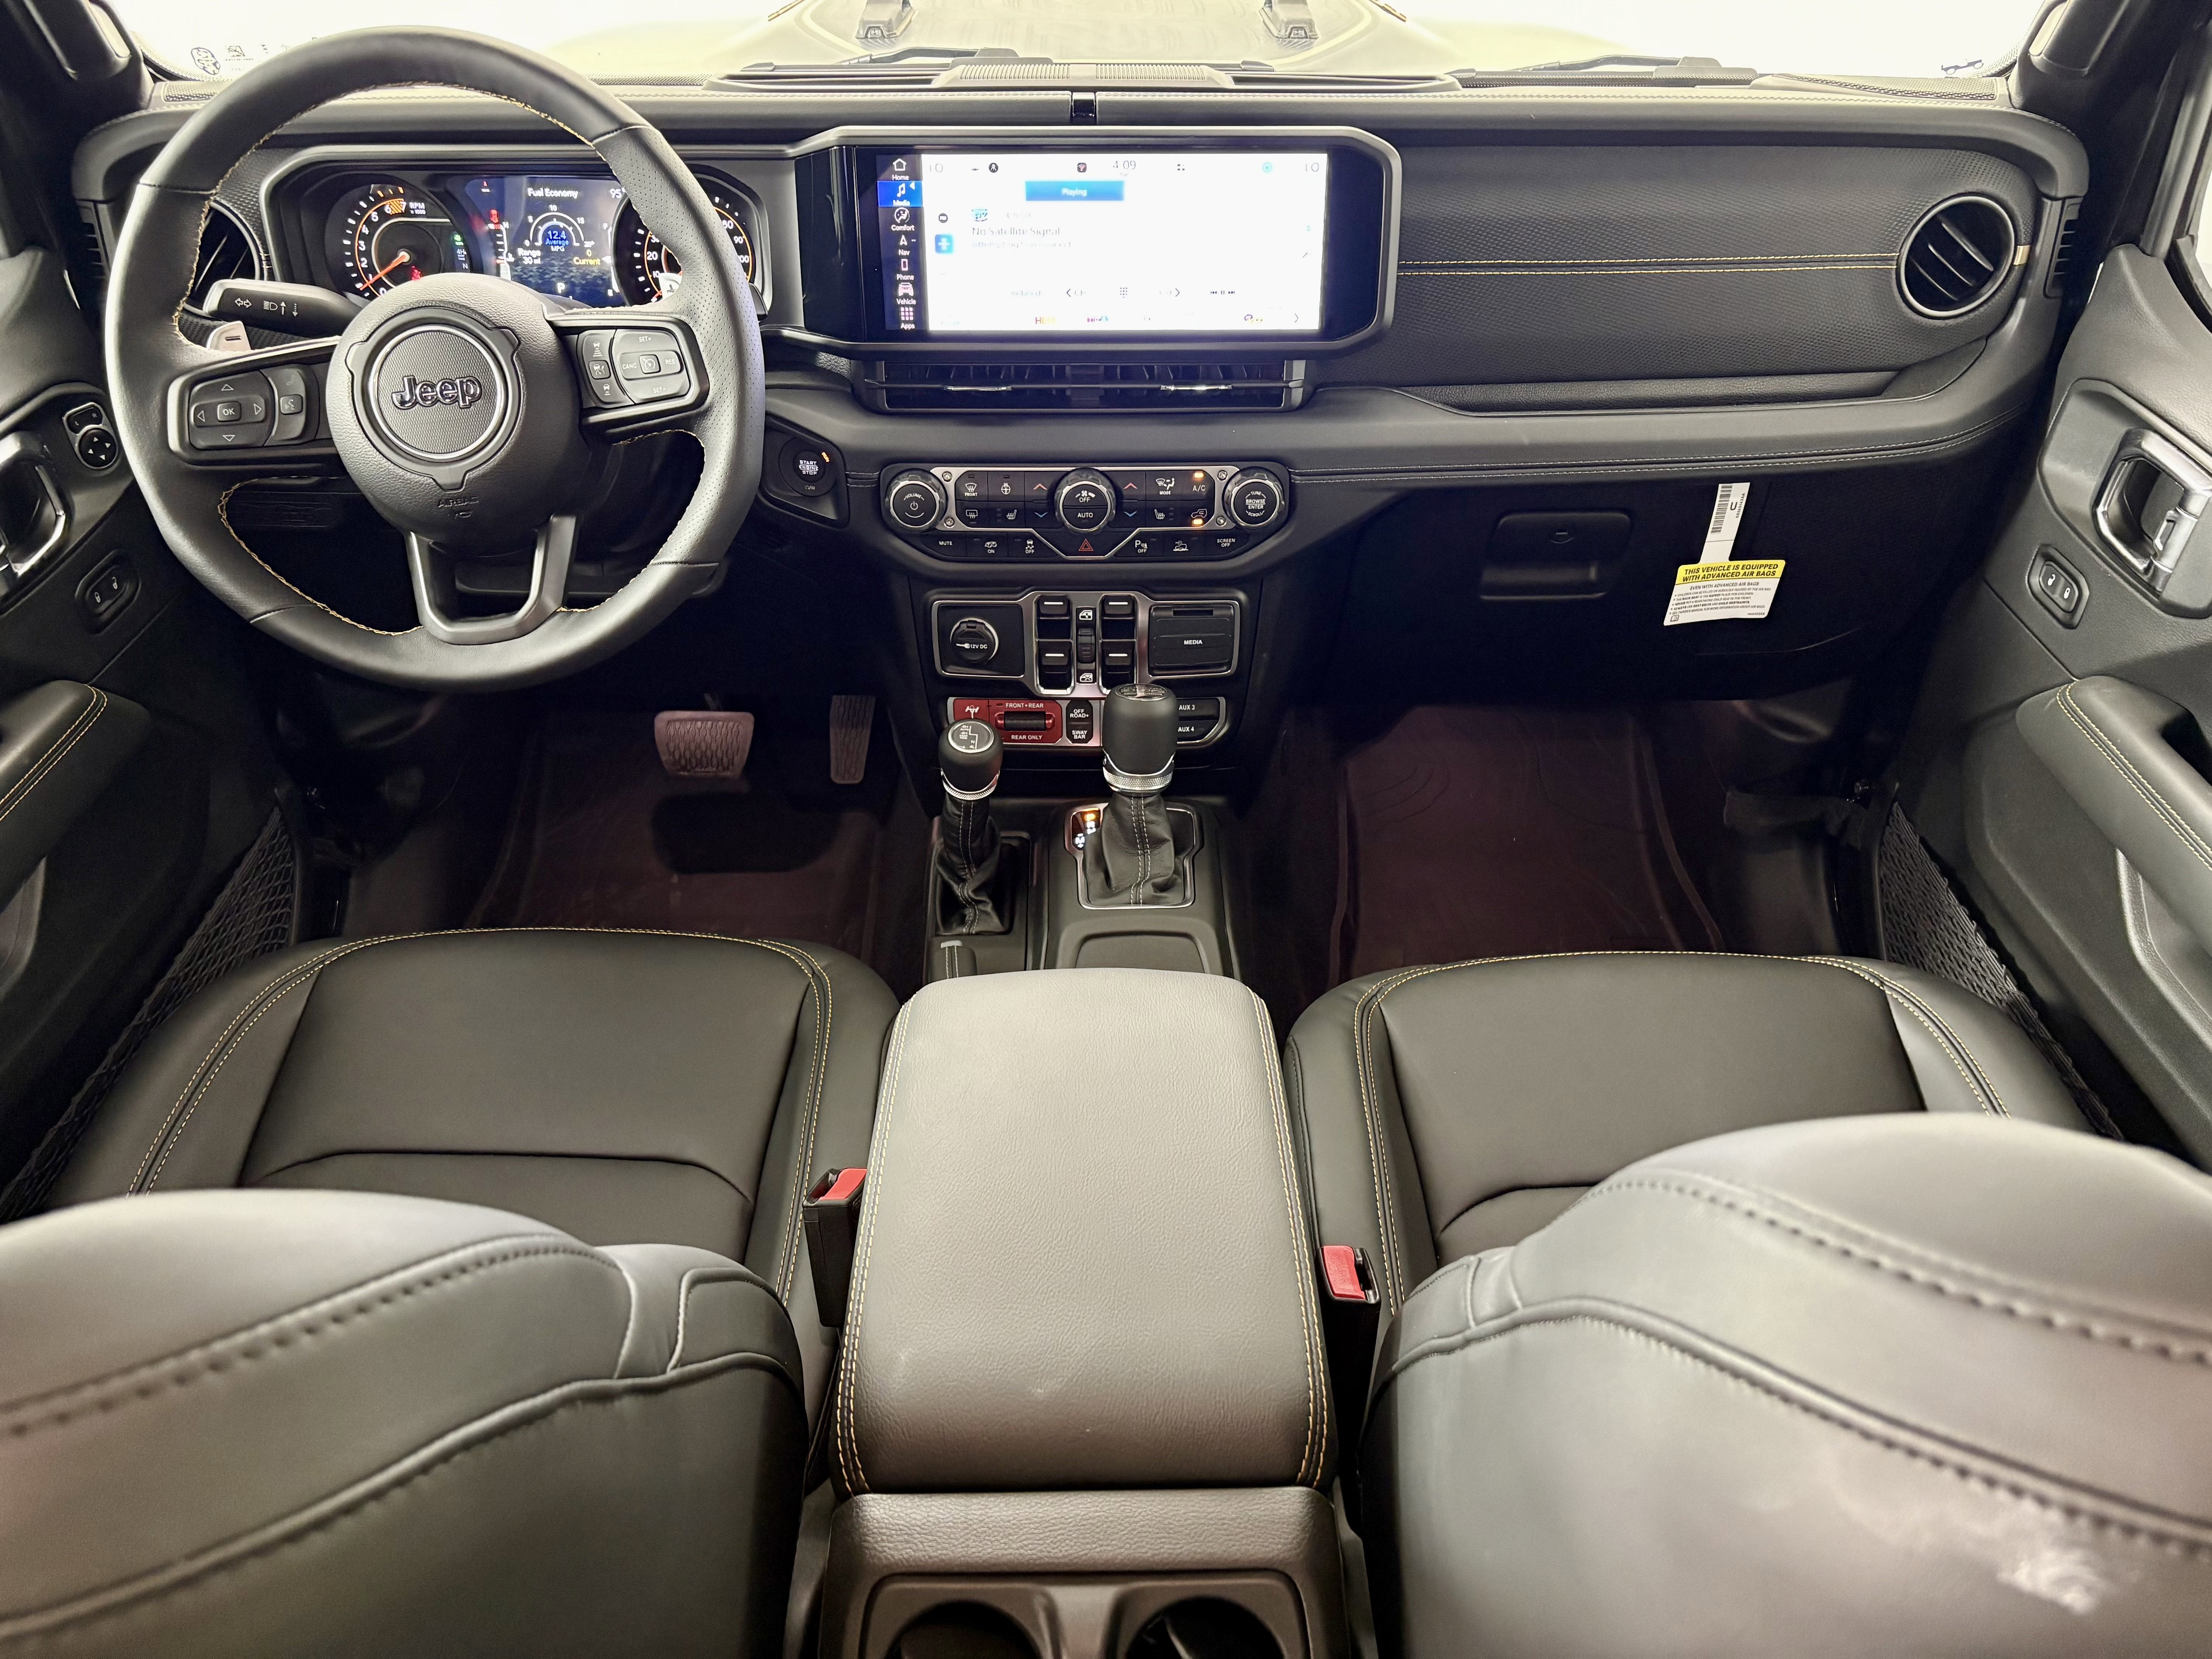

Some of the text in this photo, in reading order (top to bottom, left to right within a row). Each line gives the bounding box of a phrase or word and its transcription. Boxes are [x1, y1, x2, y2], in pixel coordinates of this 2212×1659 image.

[1113, 160, 1136, 170] 409
[527, 188, 579, 199] Fuel Economy
[1061, 188, 1087, 197] Playing
[384, 204, 392, 214] 6
[400, 201, 407, 212] 7
[371, 211, 379, 222] 5
[362, 225, 369, 234] 4
[988, 227, 1028, 235] Satellite
[1030, 227, 1060, 237] Signal
[547, 230, 567, 239] 12.4
[358, 240, 366, 251] 3
[518, 248, 541, 257] Range
[647, 251, 658, 260] 20
[361, 258, 368, 268] 2
[573, 257, 601, 265] Current
[738, 255, 749, 263] 00
[557, 282, 565, 294] P
[391, 375, 483, 411] Jeep
[1701, 571, 1740, 580] ADVANCED
[1086, 813, 1095, 821] P
[1075, 836, 1085, 845] M
